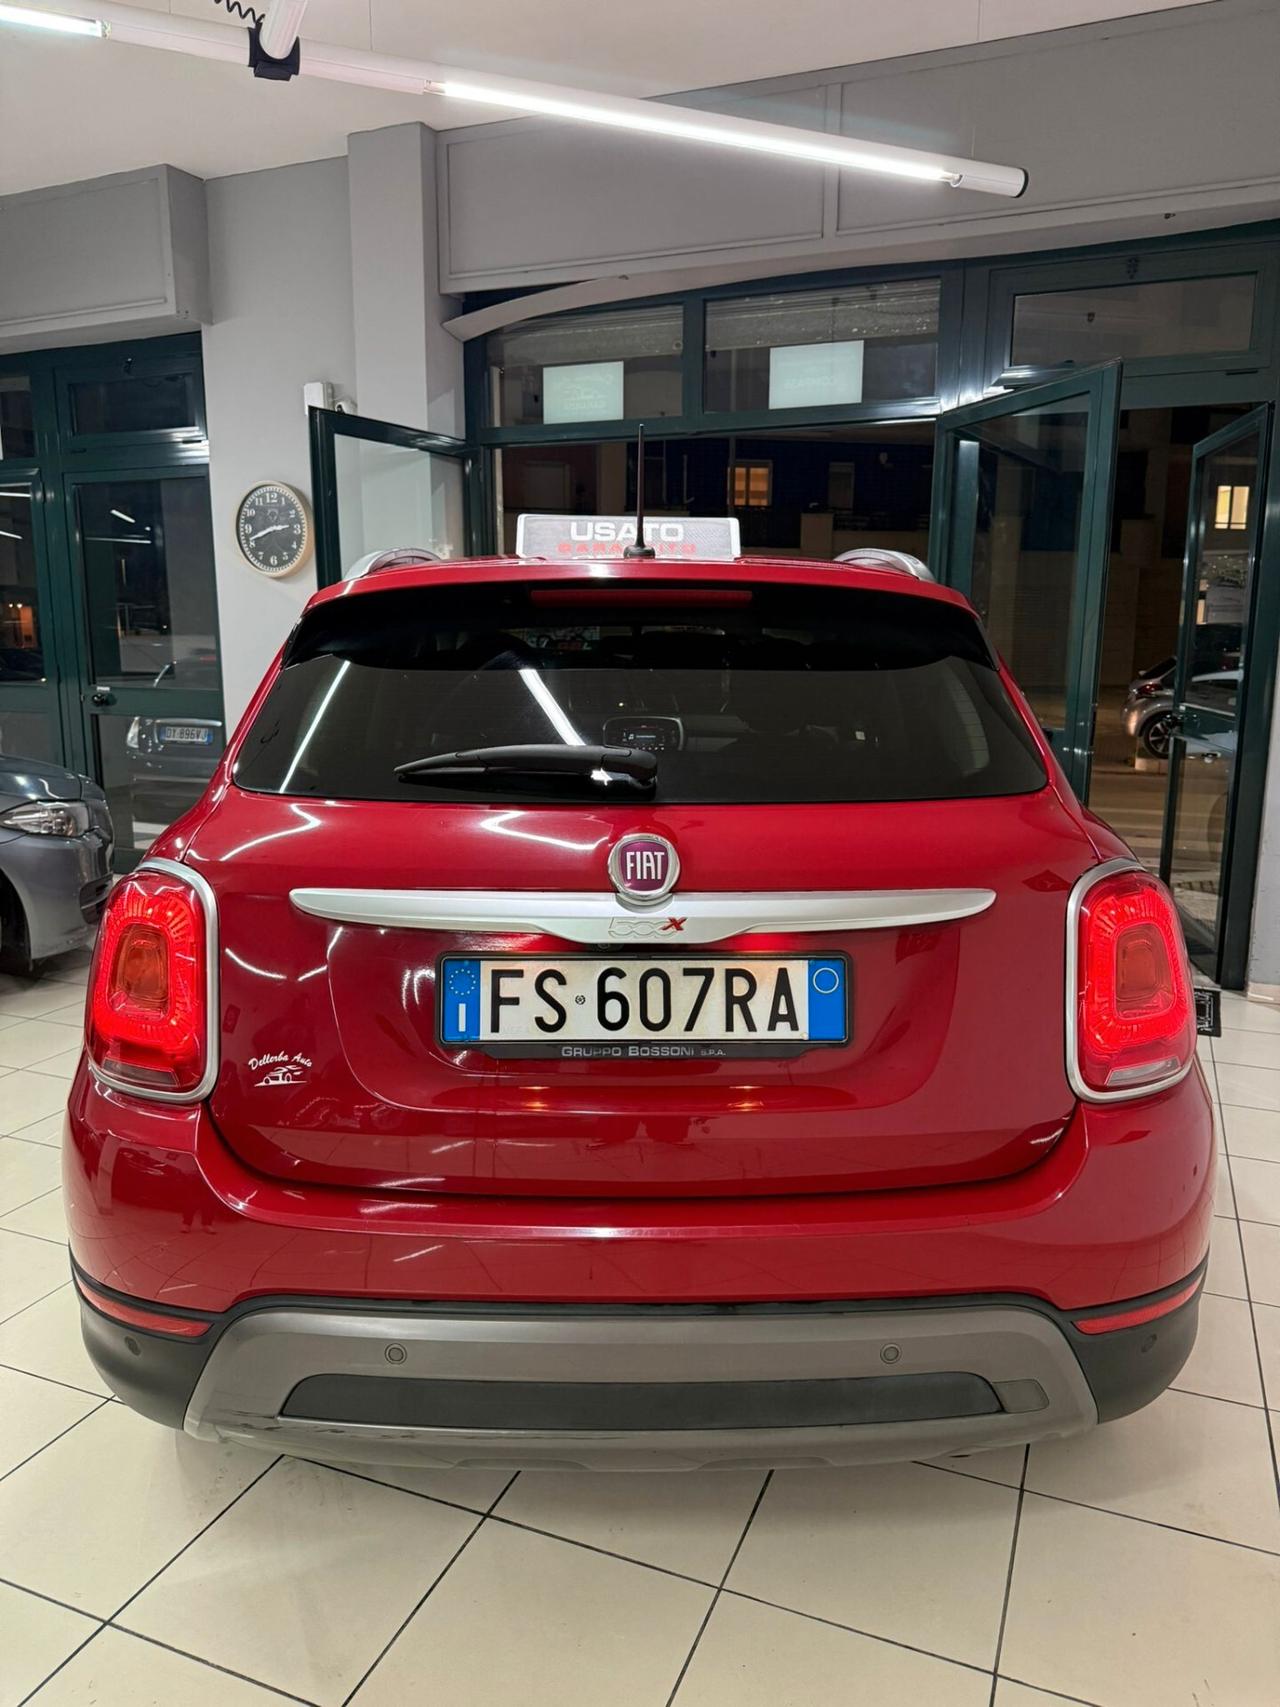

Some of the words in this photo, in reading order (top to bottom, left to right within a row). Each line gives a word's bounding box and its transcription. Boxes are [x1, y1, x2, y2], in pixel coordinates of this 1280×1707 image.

[255, 497, 263, 506] 11
[265, 492, 278, 503] 12
[281, 497, 286, 505] 1
[246, 508, 256, 517] 10
[289, 509, 296, 518] 2
[244, 523, 253, 535] 9
[293, 523, 301, 535] 3
[570, 521, 685, 542] USATO
[249, 540, 256, 549] 8
[291, 541, 297, 549] 4
[556, 543, 697, 555] GARAITO
[258, 551, 264, 560] 7
[270, 555, 278, 566] 6
[282, 551, 289, 561] 5
[626, 851, 665, 880] FIAT
[490, 968, 568, 1034] FS
[596, 967, 800, 1033] 607RA
[561, 1045, 622, 1058] GRUPPO
[628, 1045, 694, 1057] BOSSONI
[291, 1052, 313, 1067] Auto
